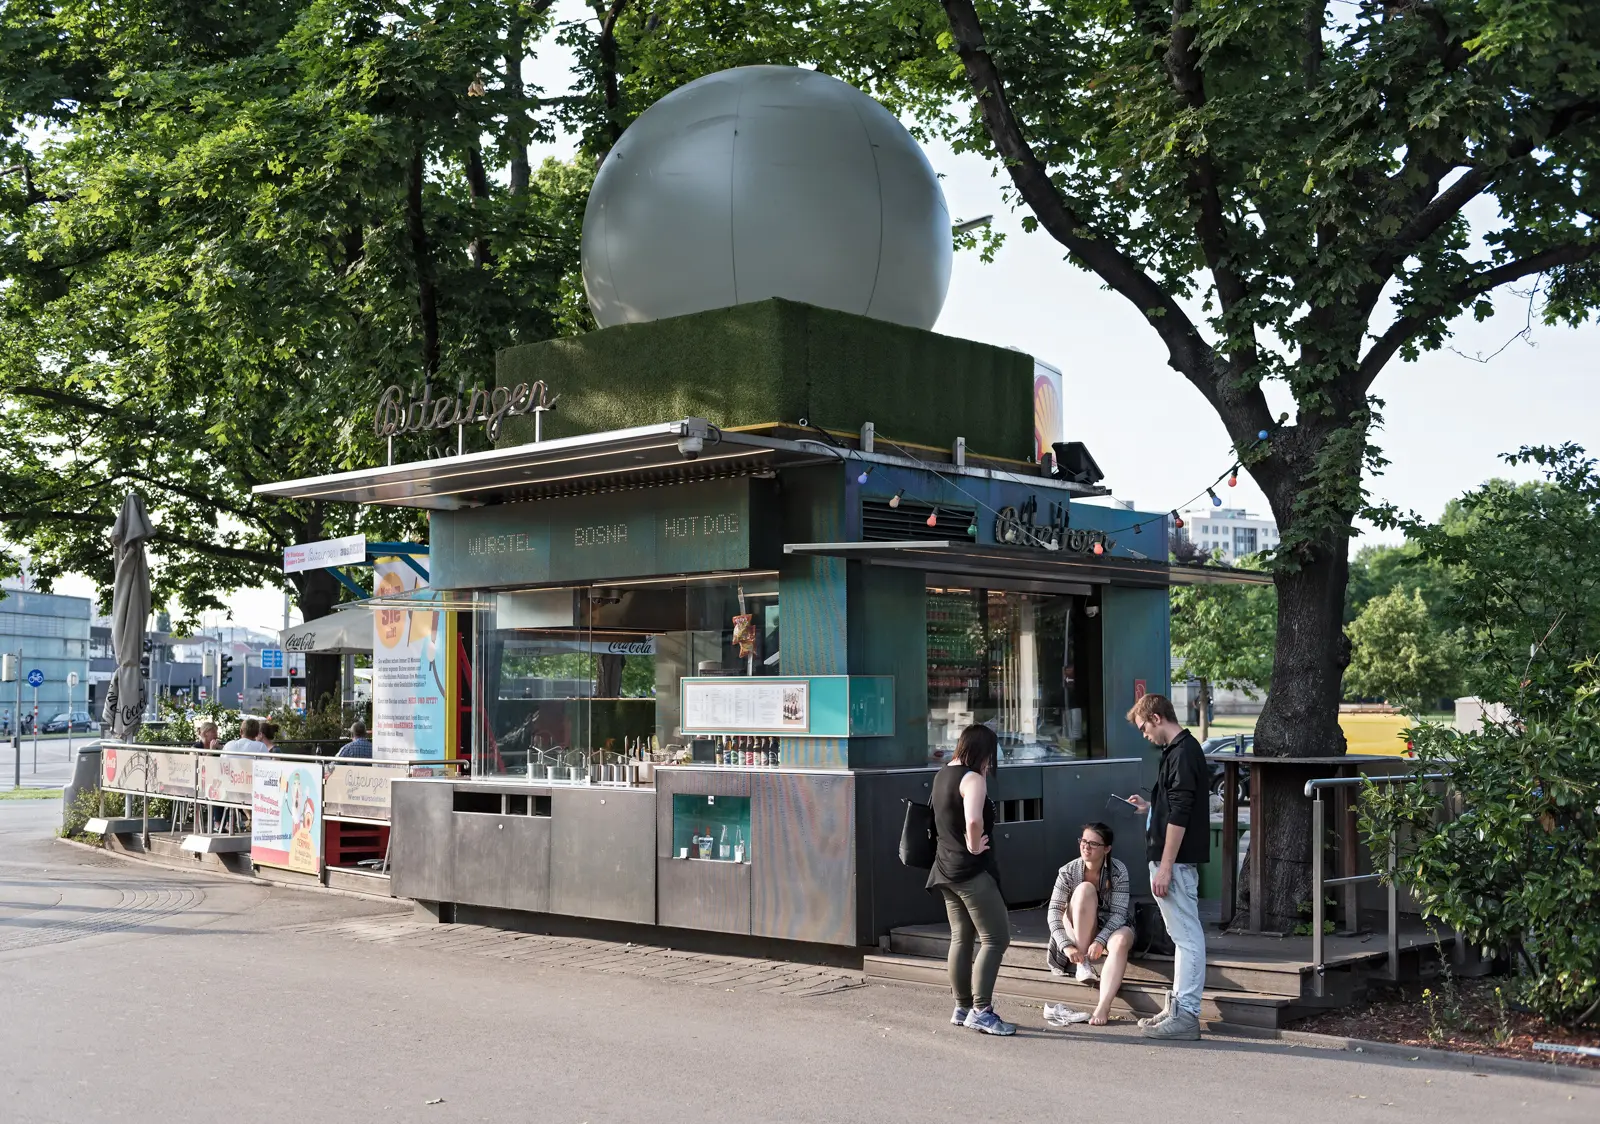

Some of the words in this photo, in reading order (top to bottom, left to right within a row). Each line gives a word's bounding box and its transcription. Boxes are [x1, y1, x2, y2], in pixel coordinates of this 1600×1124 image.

[574, 523, 628, 546] BOSNA
[664, 516, 699, 538] HOT
[704, 513, 739, 535] DOG
[220, 761, 231, 776] Viel
[231, 771, 245, 785] Spaß
